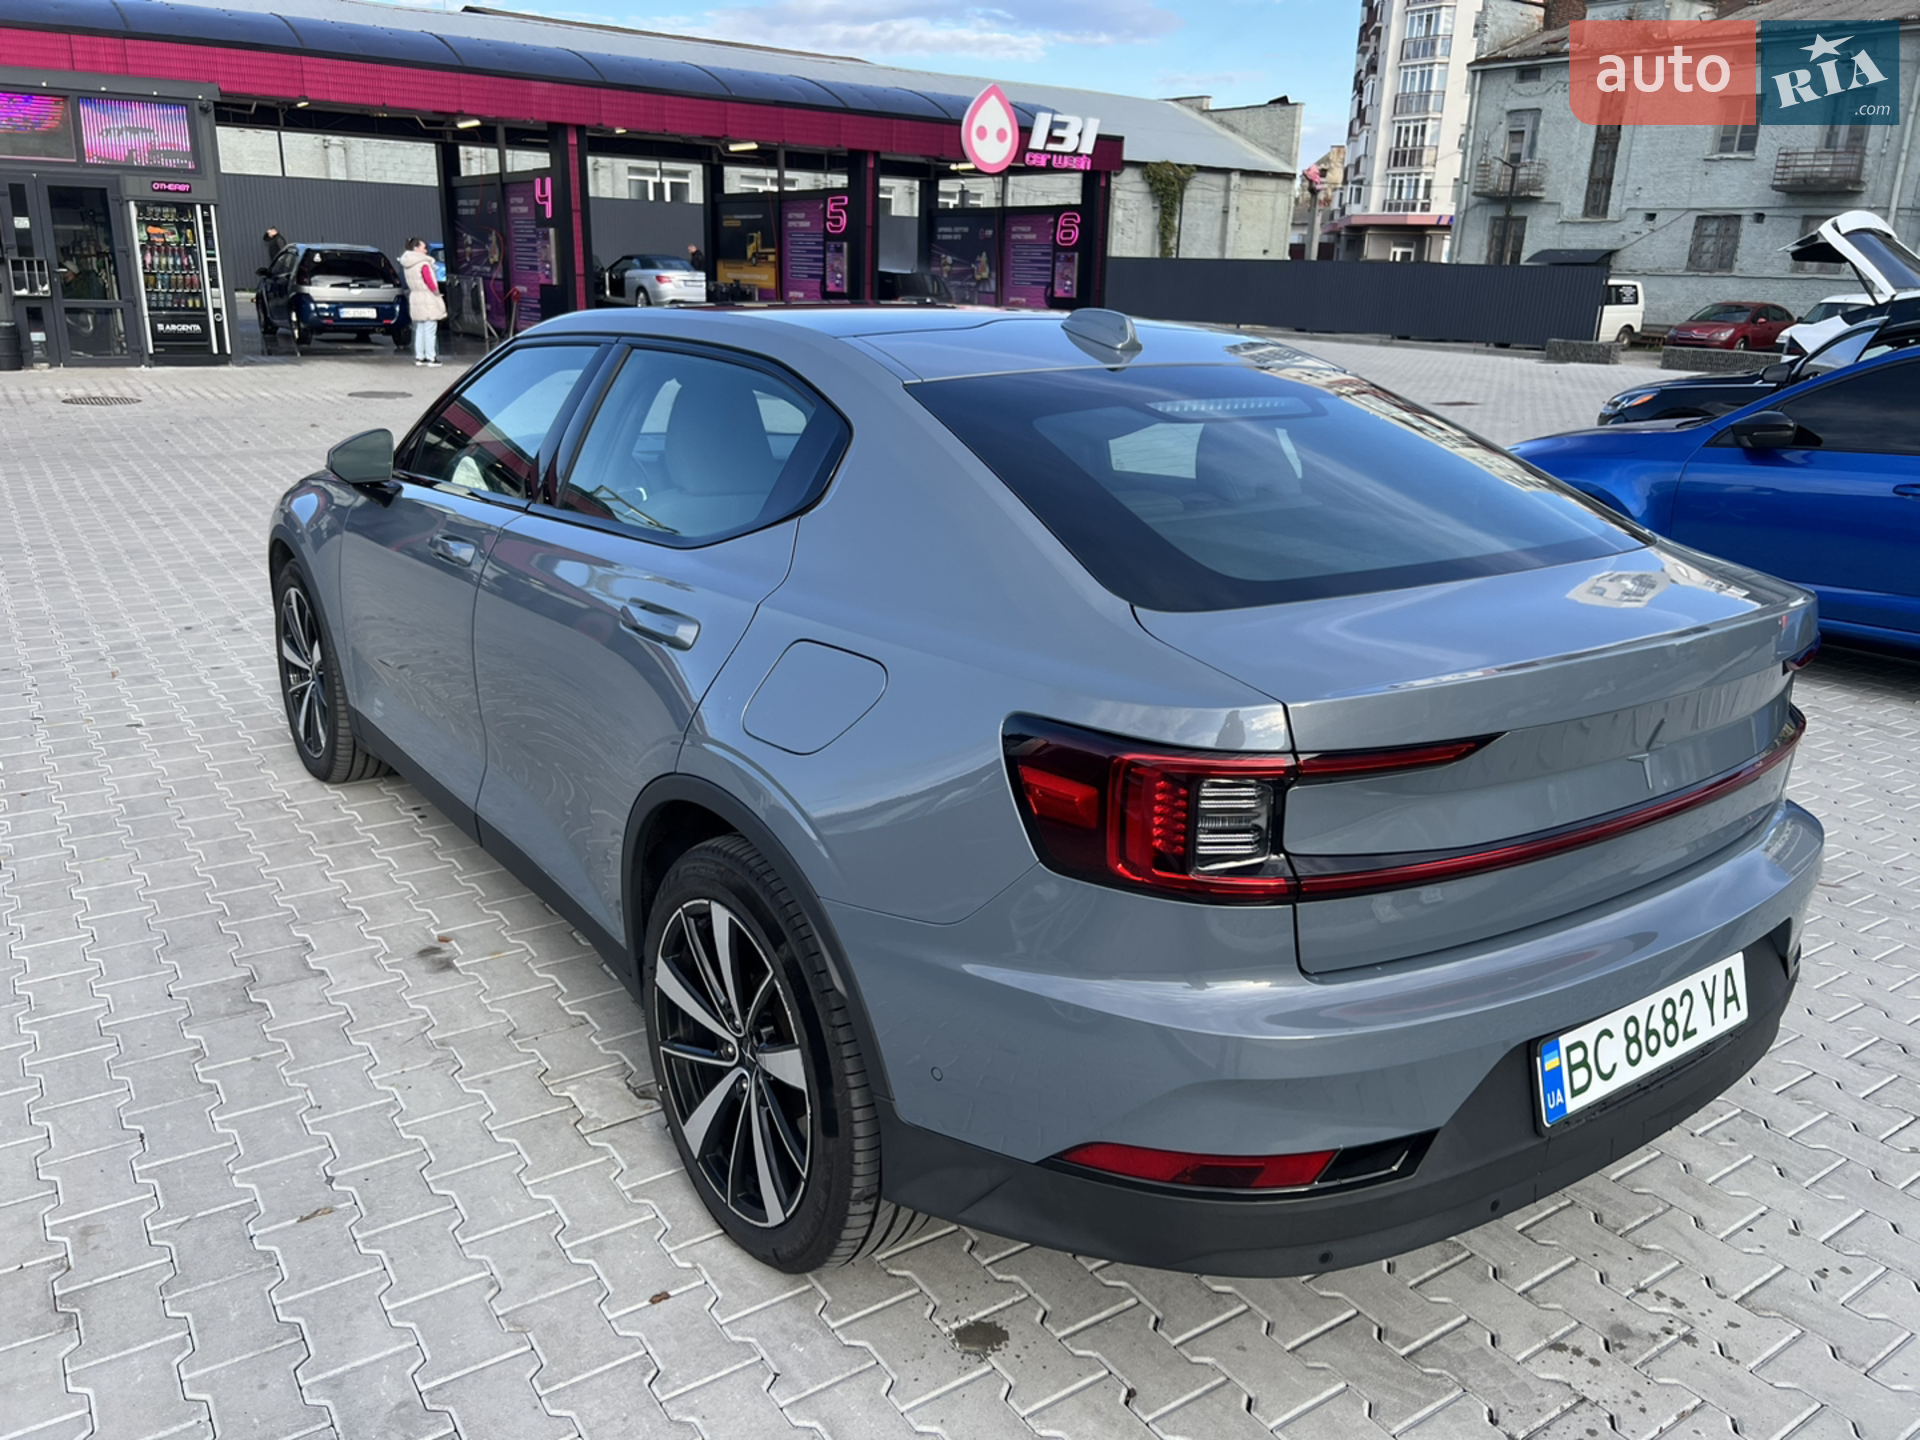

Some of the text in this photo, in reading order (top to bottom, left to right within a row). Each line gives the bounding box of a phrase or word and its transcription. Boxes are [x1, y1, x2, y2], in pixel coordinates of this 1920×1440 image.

[1028, 112, 1101, 155] 131
[1025, 152, 1092, 171] car wash
[535, 177, 552, 219] 4
[826, 196, 849, 233] 5
[1056, 212, 1081, 246] 6
[165, 323, 202, 332] ARGENTA
[1565, 966, 1741, 1099] BC 8682 YA
[1547, 1088, 1565, 1109] UA
